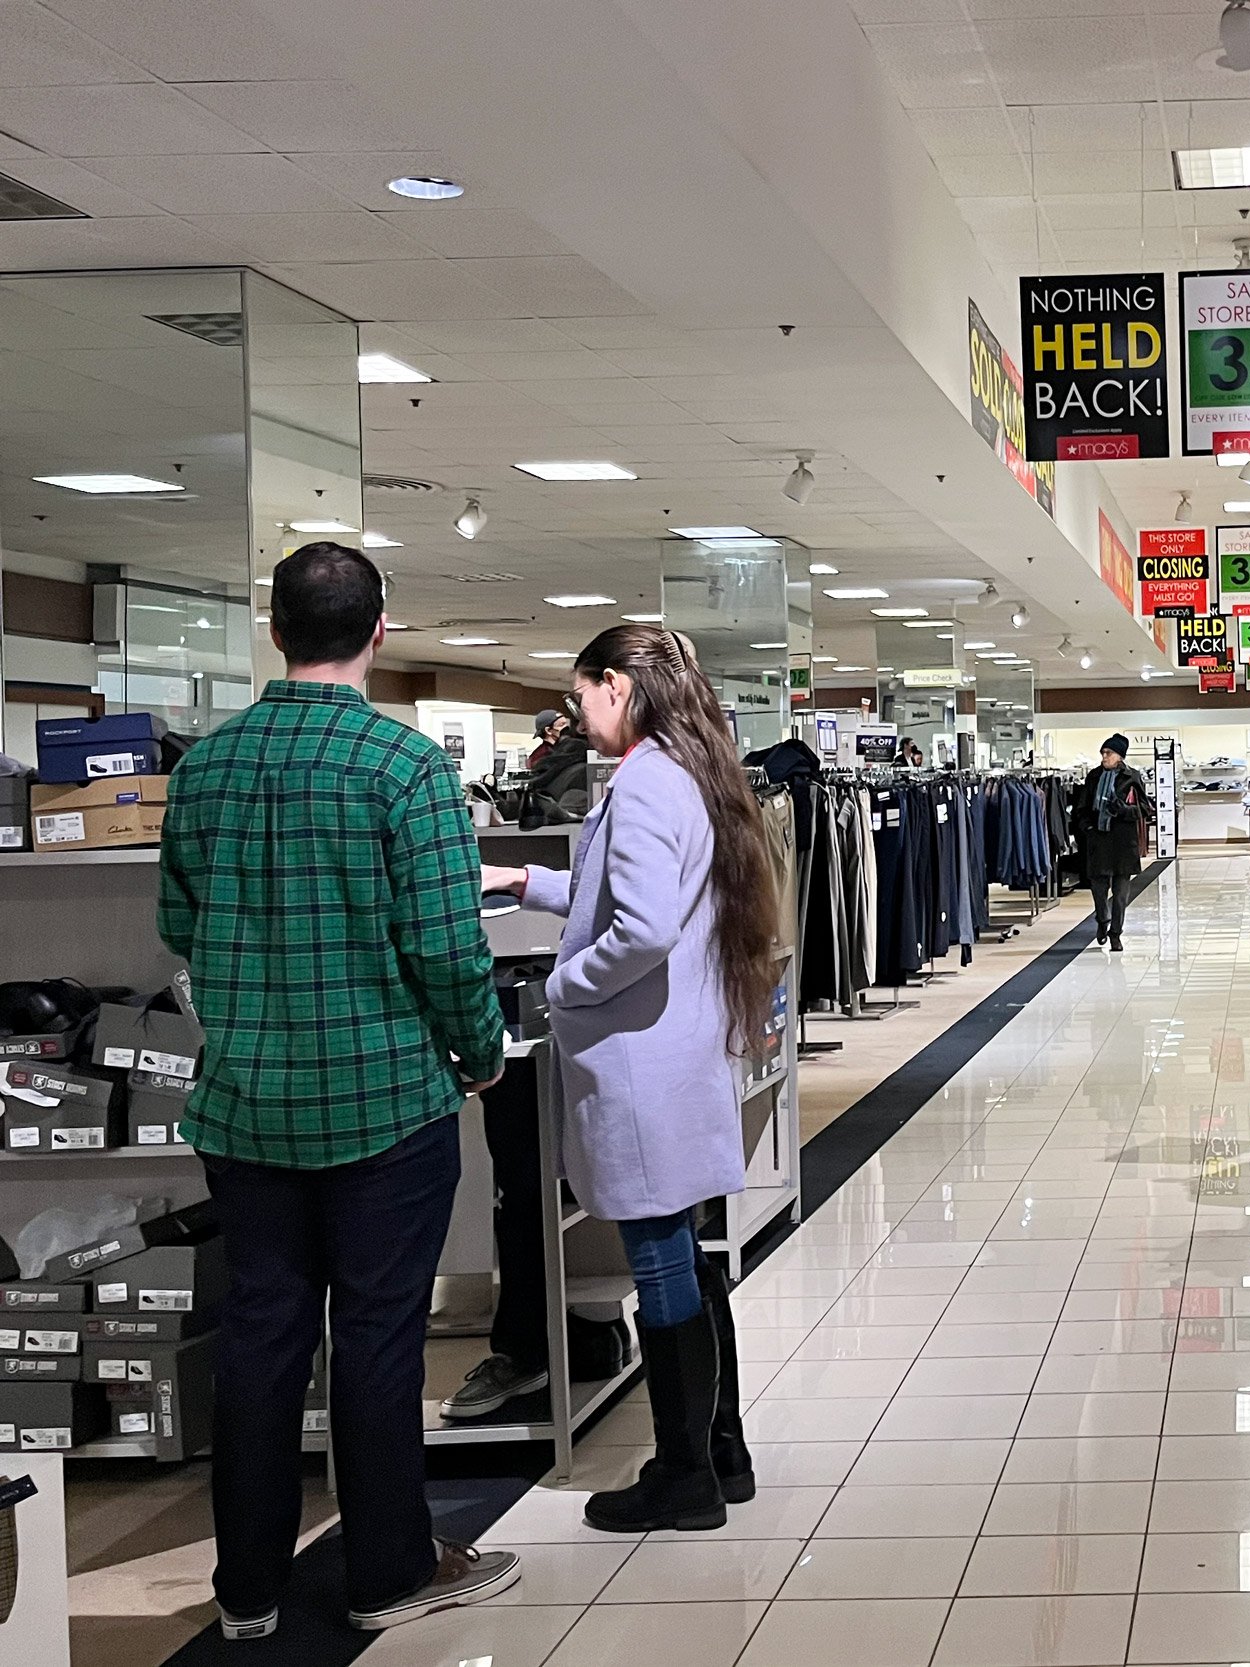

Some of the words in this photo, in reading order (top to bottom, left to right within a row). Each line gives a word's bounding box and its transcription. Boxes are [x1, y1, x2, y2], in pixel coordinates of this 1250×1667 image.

[1031, 286, 1155, 313] NOTHING
[1033, 322, 1161, 371] HELD
[1035, 378, 1163, 419] BACK!
[1191, 414, 1224, 423] EVERY
[1078, 440, 1129, 458] macy's
[1149, 534, 1166, 543] THIS
[1168, 533, 1196, 543] STORE
[1160, 544, 1184, 554] ONLY
[1143, 557, 1203, 579] CLOSING
[1148, 582, 1199, 592] EVERYTHING
[1153, 593, 1175, 601] MUST
[1177, 592, 1194, 601] GO!
[1180, 618, 1225, 637] HELD
[1181, 638, 1226, 653] BACK!
[913, 674, 930, 682] Price
